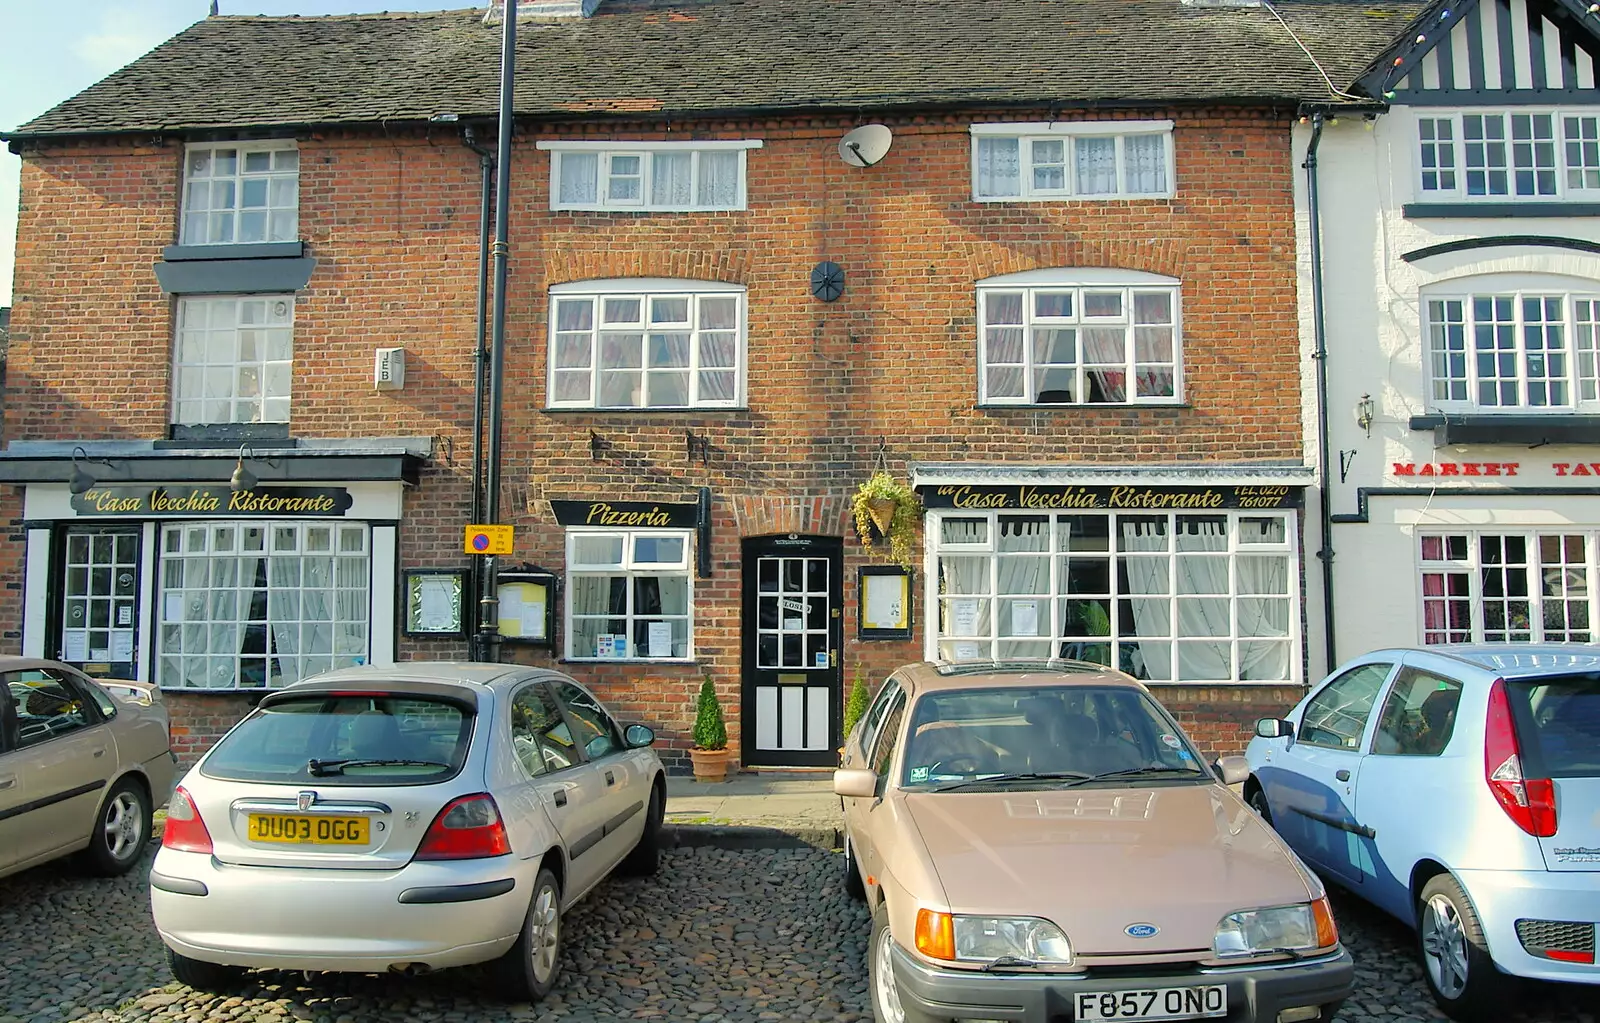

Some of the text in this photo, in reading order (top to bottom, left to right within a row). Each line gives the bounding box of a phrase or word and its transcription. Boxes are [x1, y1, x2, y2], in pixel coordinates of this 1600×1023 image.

[381, 351, 389, 380] JEB
[1393, 462, 1519, 476] MARKET
[96, 489, 142, 511] Casa
[150, 489, 220, 511] Vecchia
[228, 490, 336, 511] Ristorante
[953, 485, 1009, 508] Casa
[1019, 485, 1098, 508] Vecchia
[1109, 486, 1224, 508] Ristorante
[1239, 496, 1283, 508] 761077
[586, 502, 671, 526] Pizzeria
[257, 816, 360, 841] DU03 OGG
[1132, 925, 1152, 936] Ford
[1079, 990, 1158, 1019] F857
